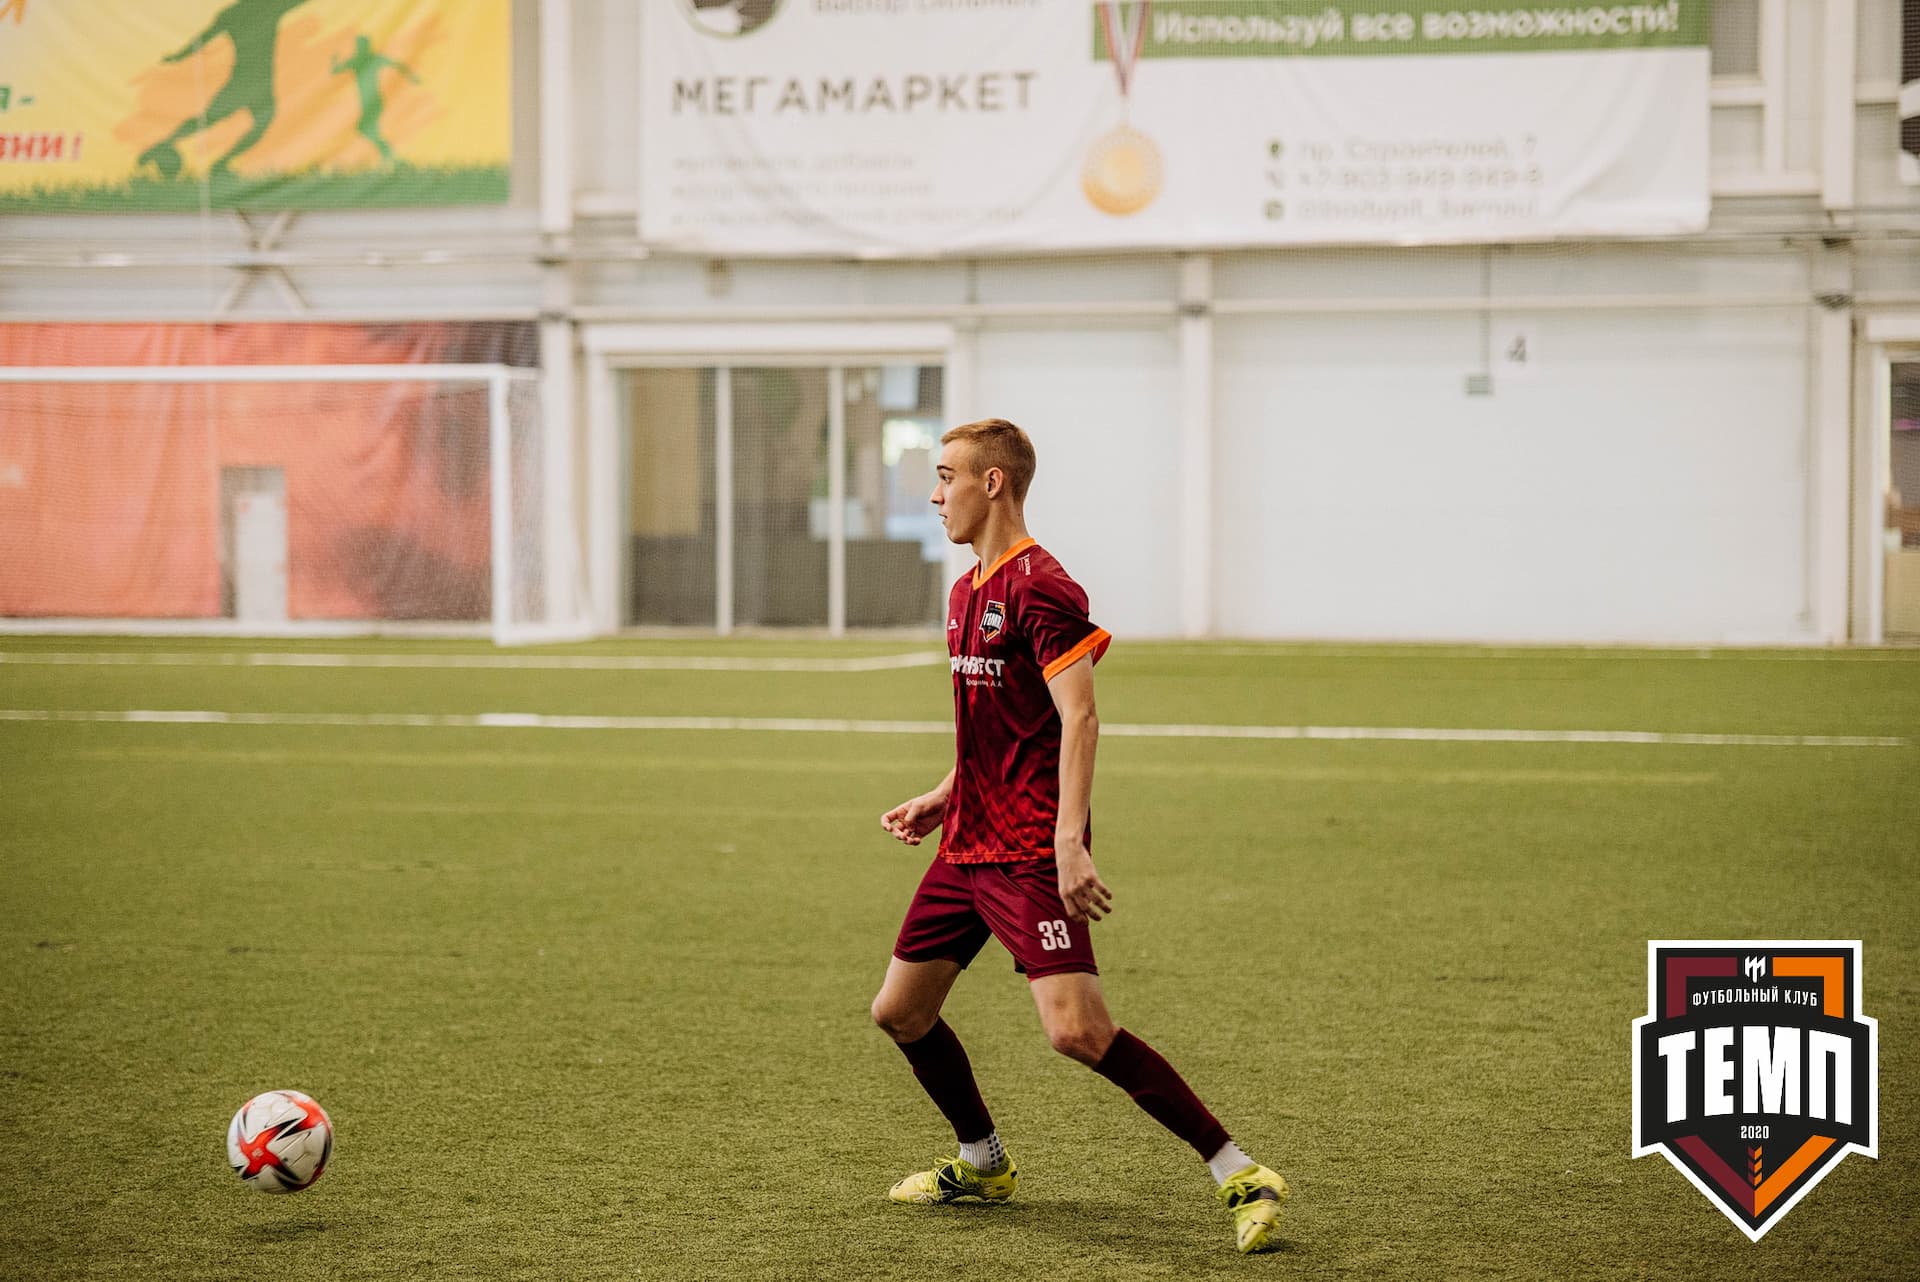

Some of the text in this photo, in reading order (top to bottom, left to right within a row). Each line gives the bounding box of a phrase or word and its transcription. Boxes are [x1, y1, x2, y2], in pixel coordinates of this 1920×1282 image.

[1153, 1, 1679, 48] Используй все возможности!
[674, 72, 1036, 115] МЕГАМАРКЕТ
[1038, 919, 1072, 951] 33
